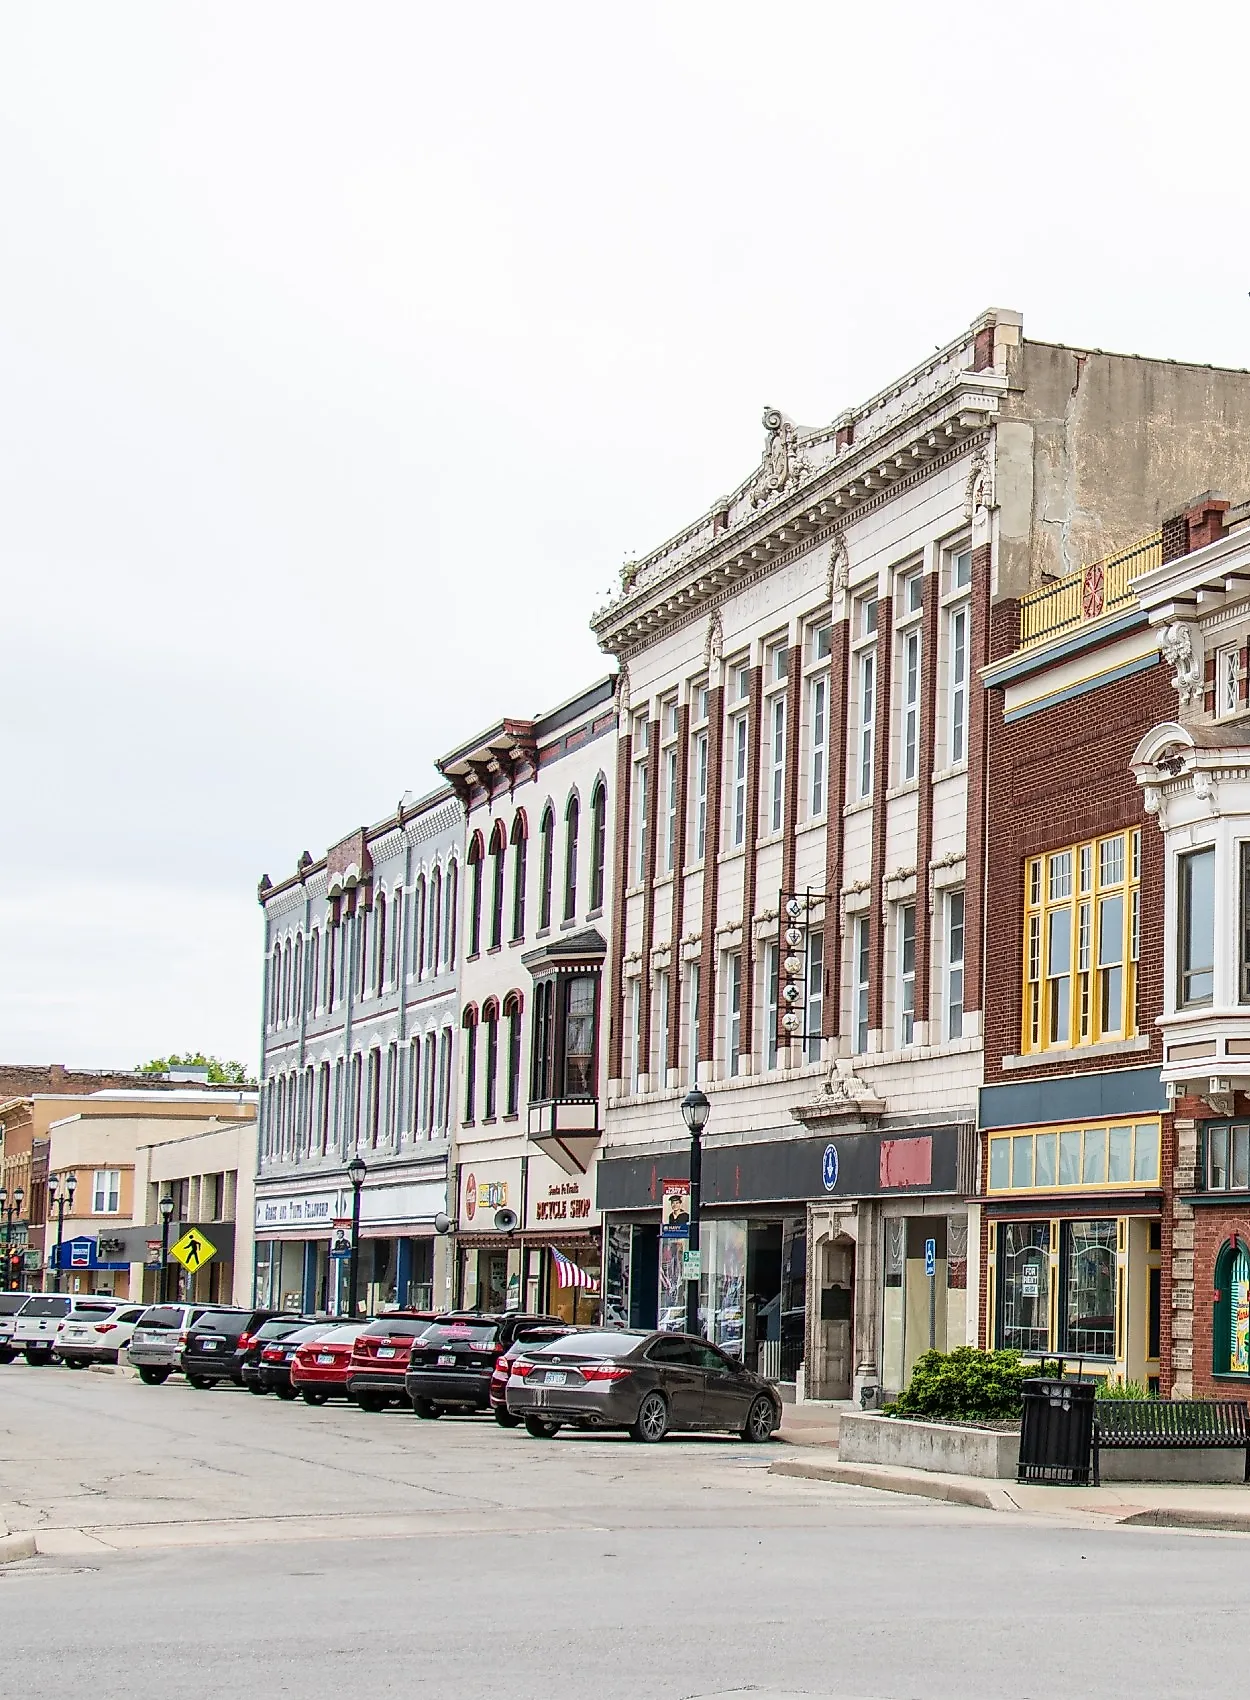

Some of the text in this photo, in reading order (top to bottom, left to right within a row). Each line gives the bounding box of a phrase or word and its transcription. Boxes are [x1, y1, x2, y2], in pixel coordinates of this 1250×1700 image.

[561, 1183, 566, 1195] Fe
[536, 1198, 591, 1220] BICYCLE SHOP
[1025, 1267, 1036, 1276] FOR
[1024, 1276, 1037, 1284] RENT
